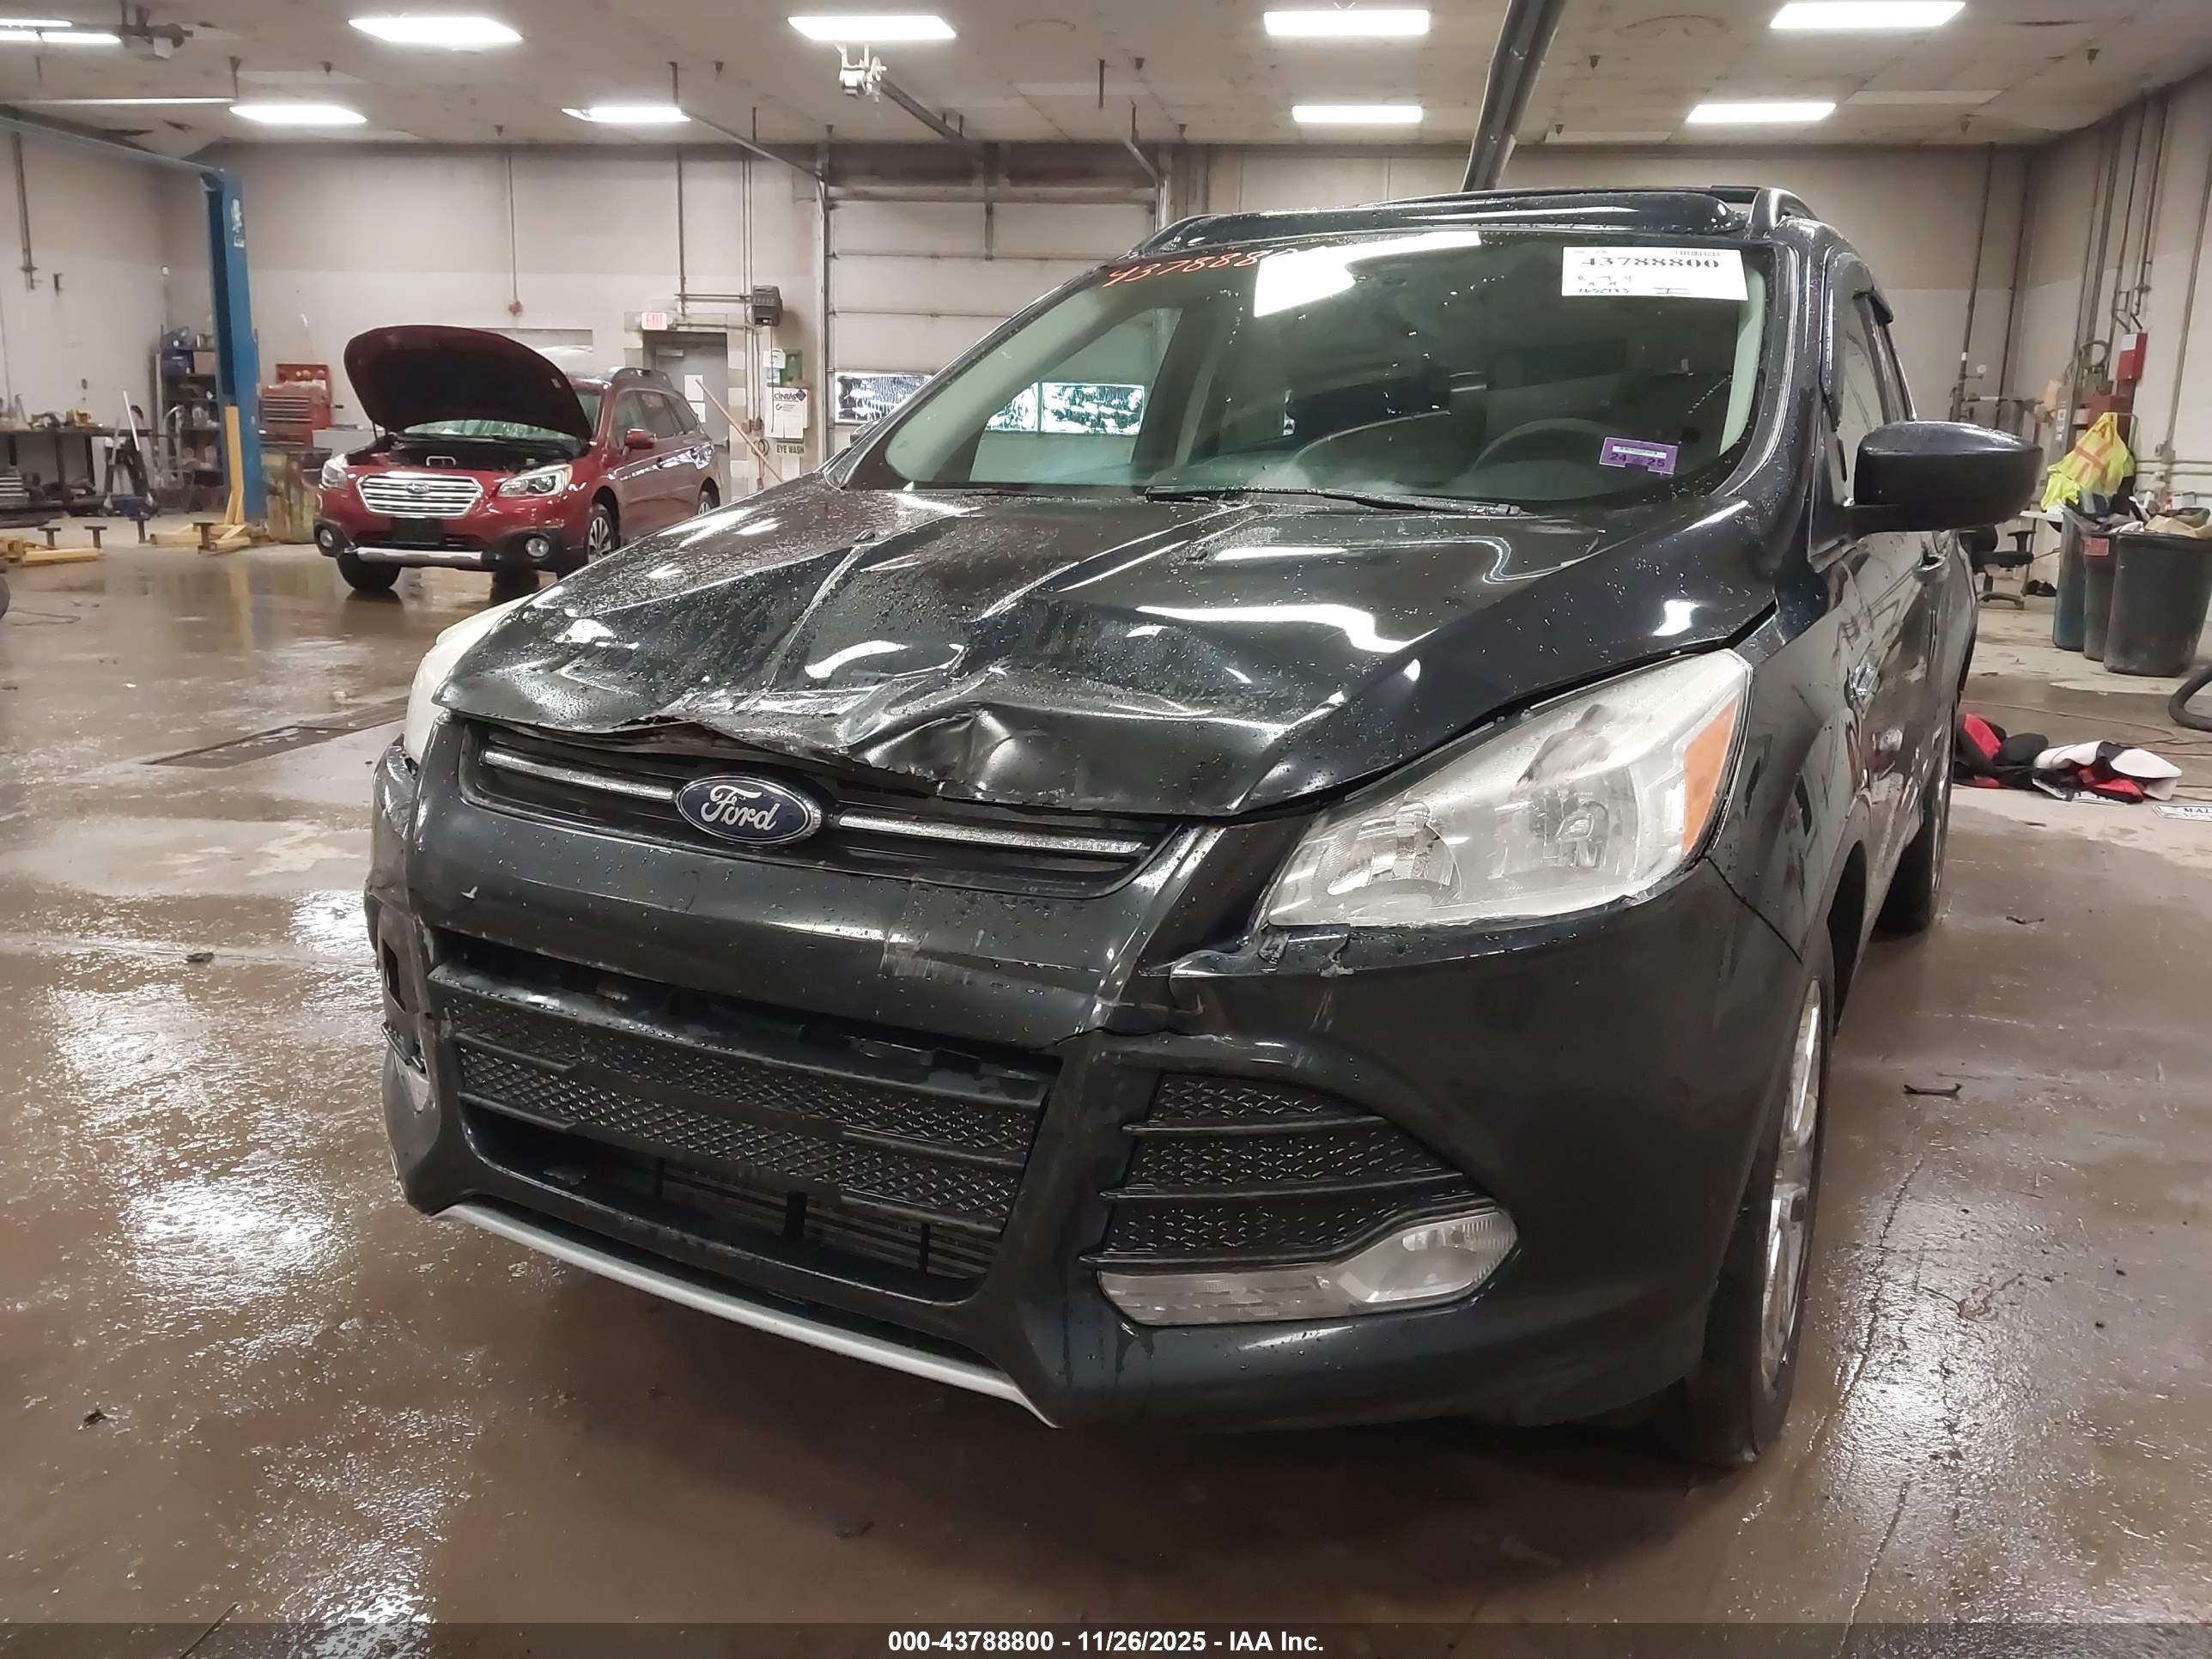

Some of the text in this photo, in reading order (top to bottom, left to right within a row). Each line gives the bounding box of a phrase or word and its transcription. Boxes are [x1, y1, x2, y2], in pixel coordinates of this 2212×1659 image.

[1582, 257, 1719, 268] 43788800
[776, 444, 805, 454] EYE WASH
[1609, 453, 1627, 462] 24
[701, 785, 781, 831] Ford
